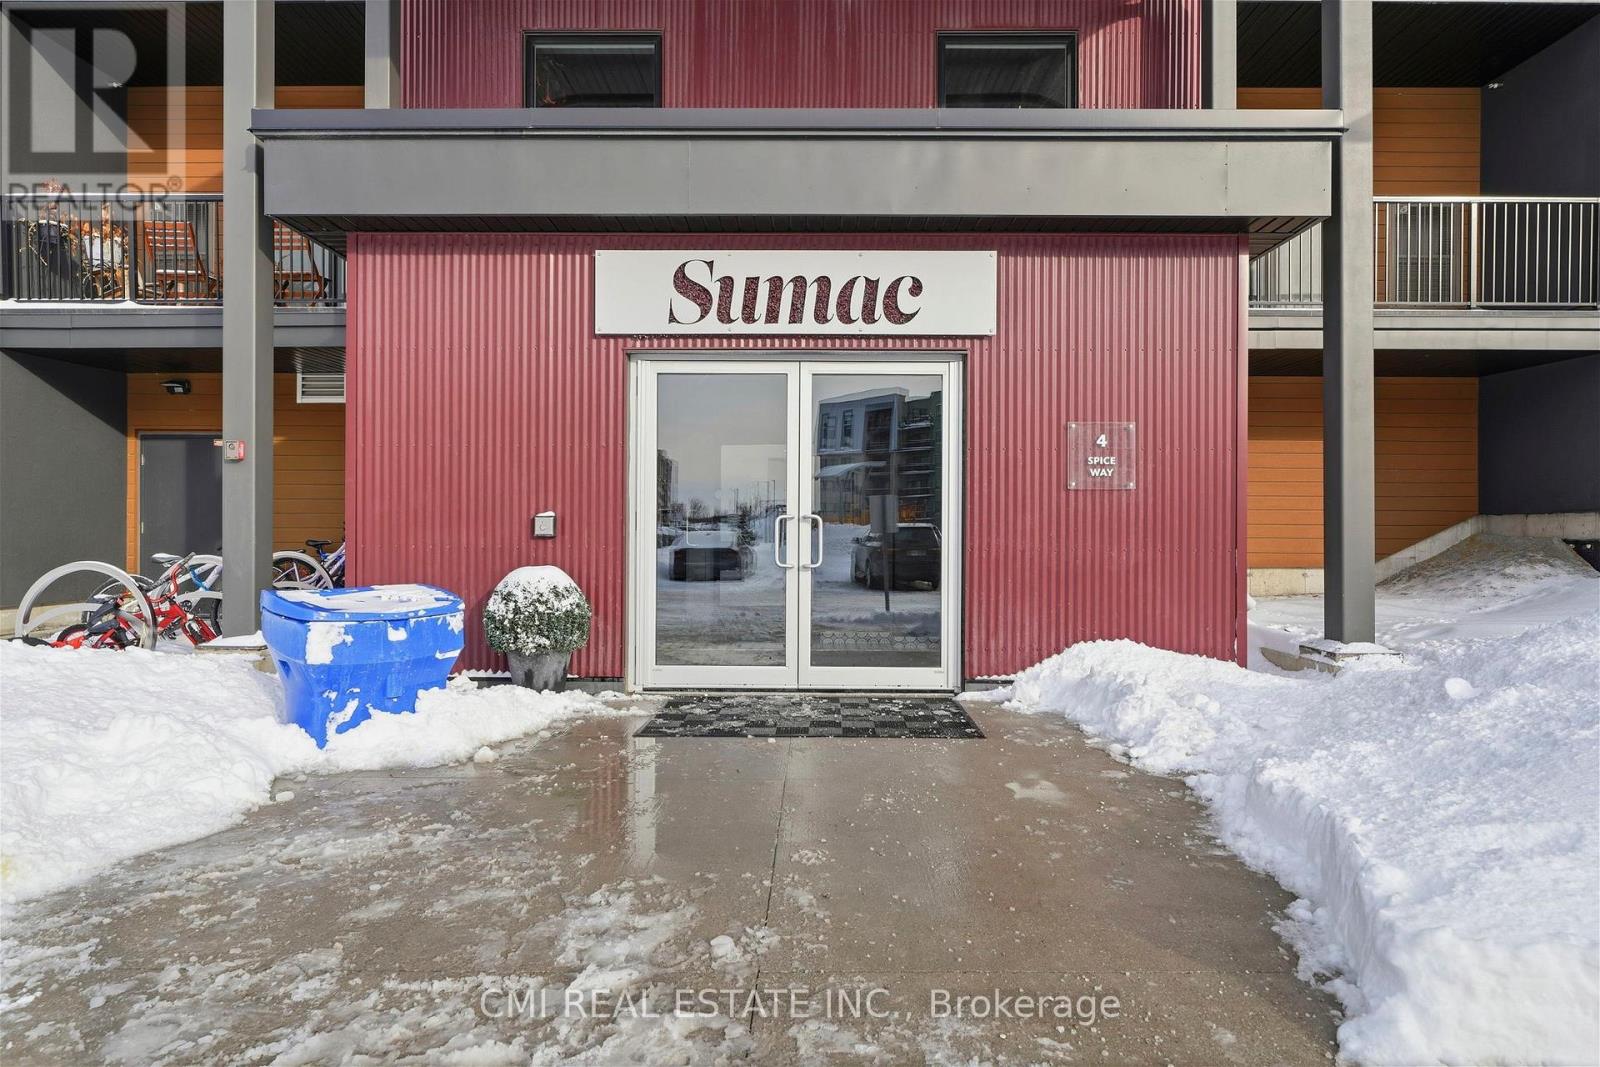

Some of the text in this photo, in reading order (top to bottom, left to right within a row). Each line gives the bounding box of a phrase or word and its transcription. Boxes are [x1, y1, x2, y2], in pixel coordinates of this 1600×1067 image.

[668, 258, 924, 325] Sumac
[1096, 434, 1108, 448] 4
[1087, 456, 1116, 465] SPICE
[1089, 468, 1114, 477] WAY
